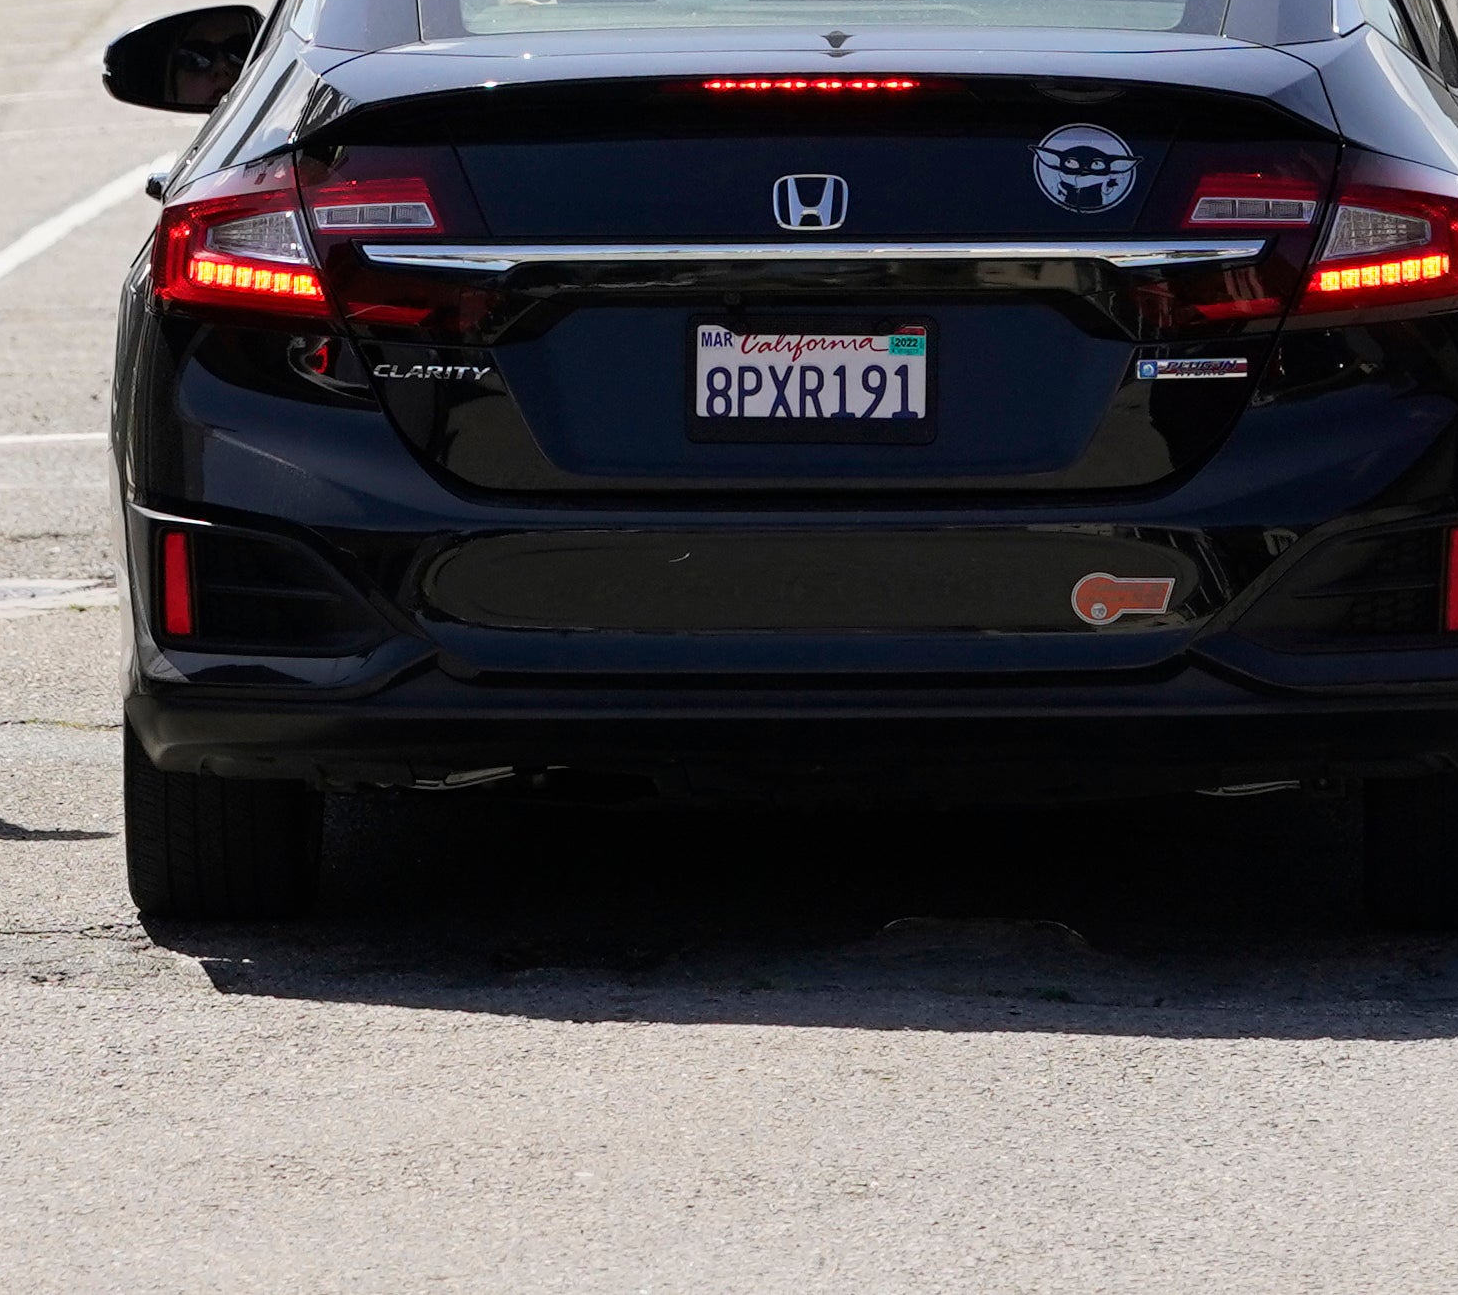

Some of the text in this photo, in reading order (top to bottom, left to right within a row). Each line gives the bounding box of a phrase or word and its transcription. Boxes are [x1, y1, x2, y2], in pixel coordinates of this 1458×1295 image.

[701, 332, 918, 362] MAR California 2022
[373, 364, 491, 380] CLARITY
[706, 365, 919, 418] 8PXR191
